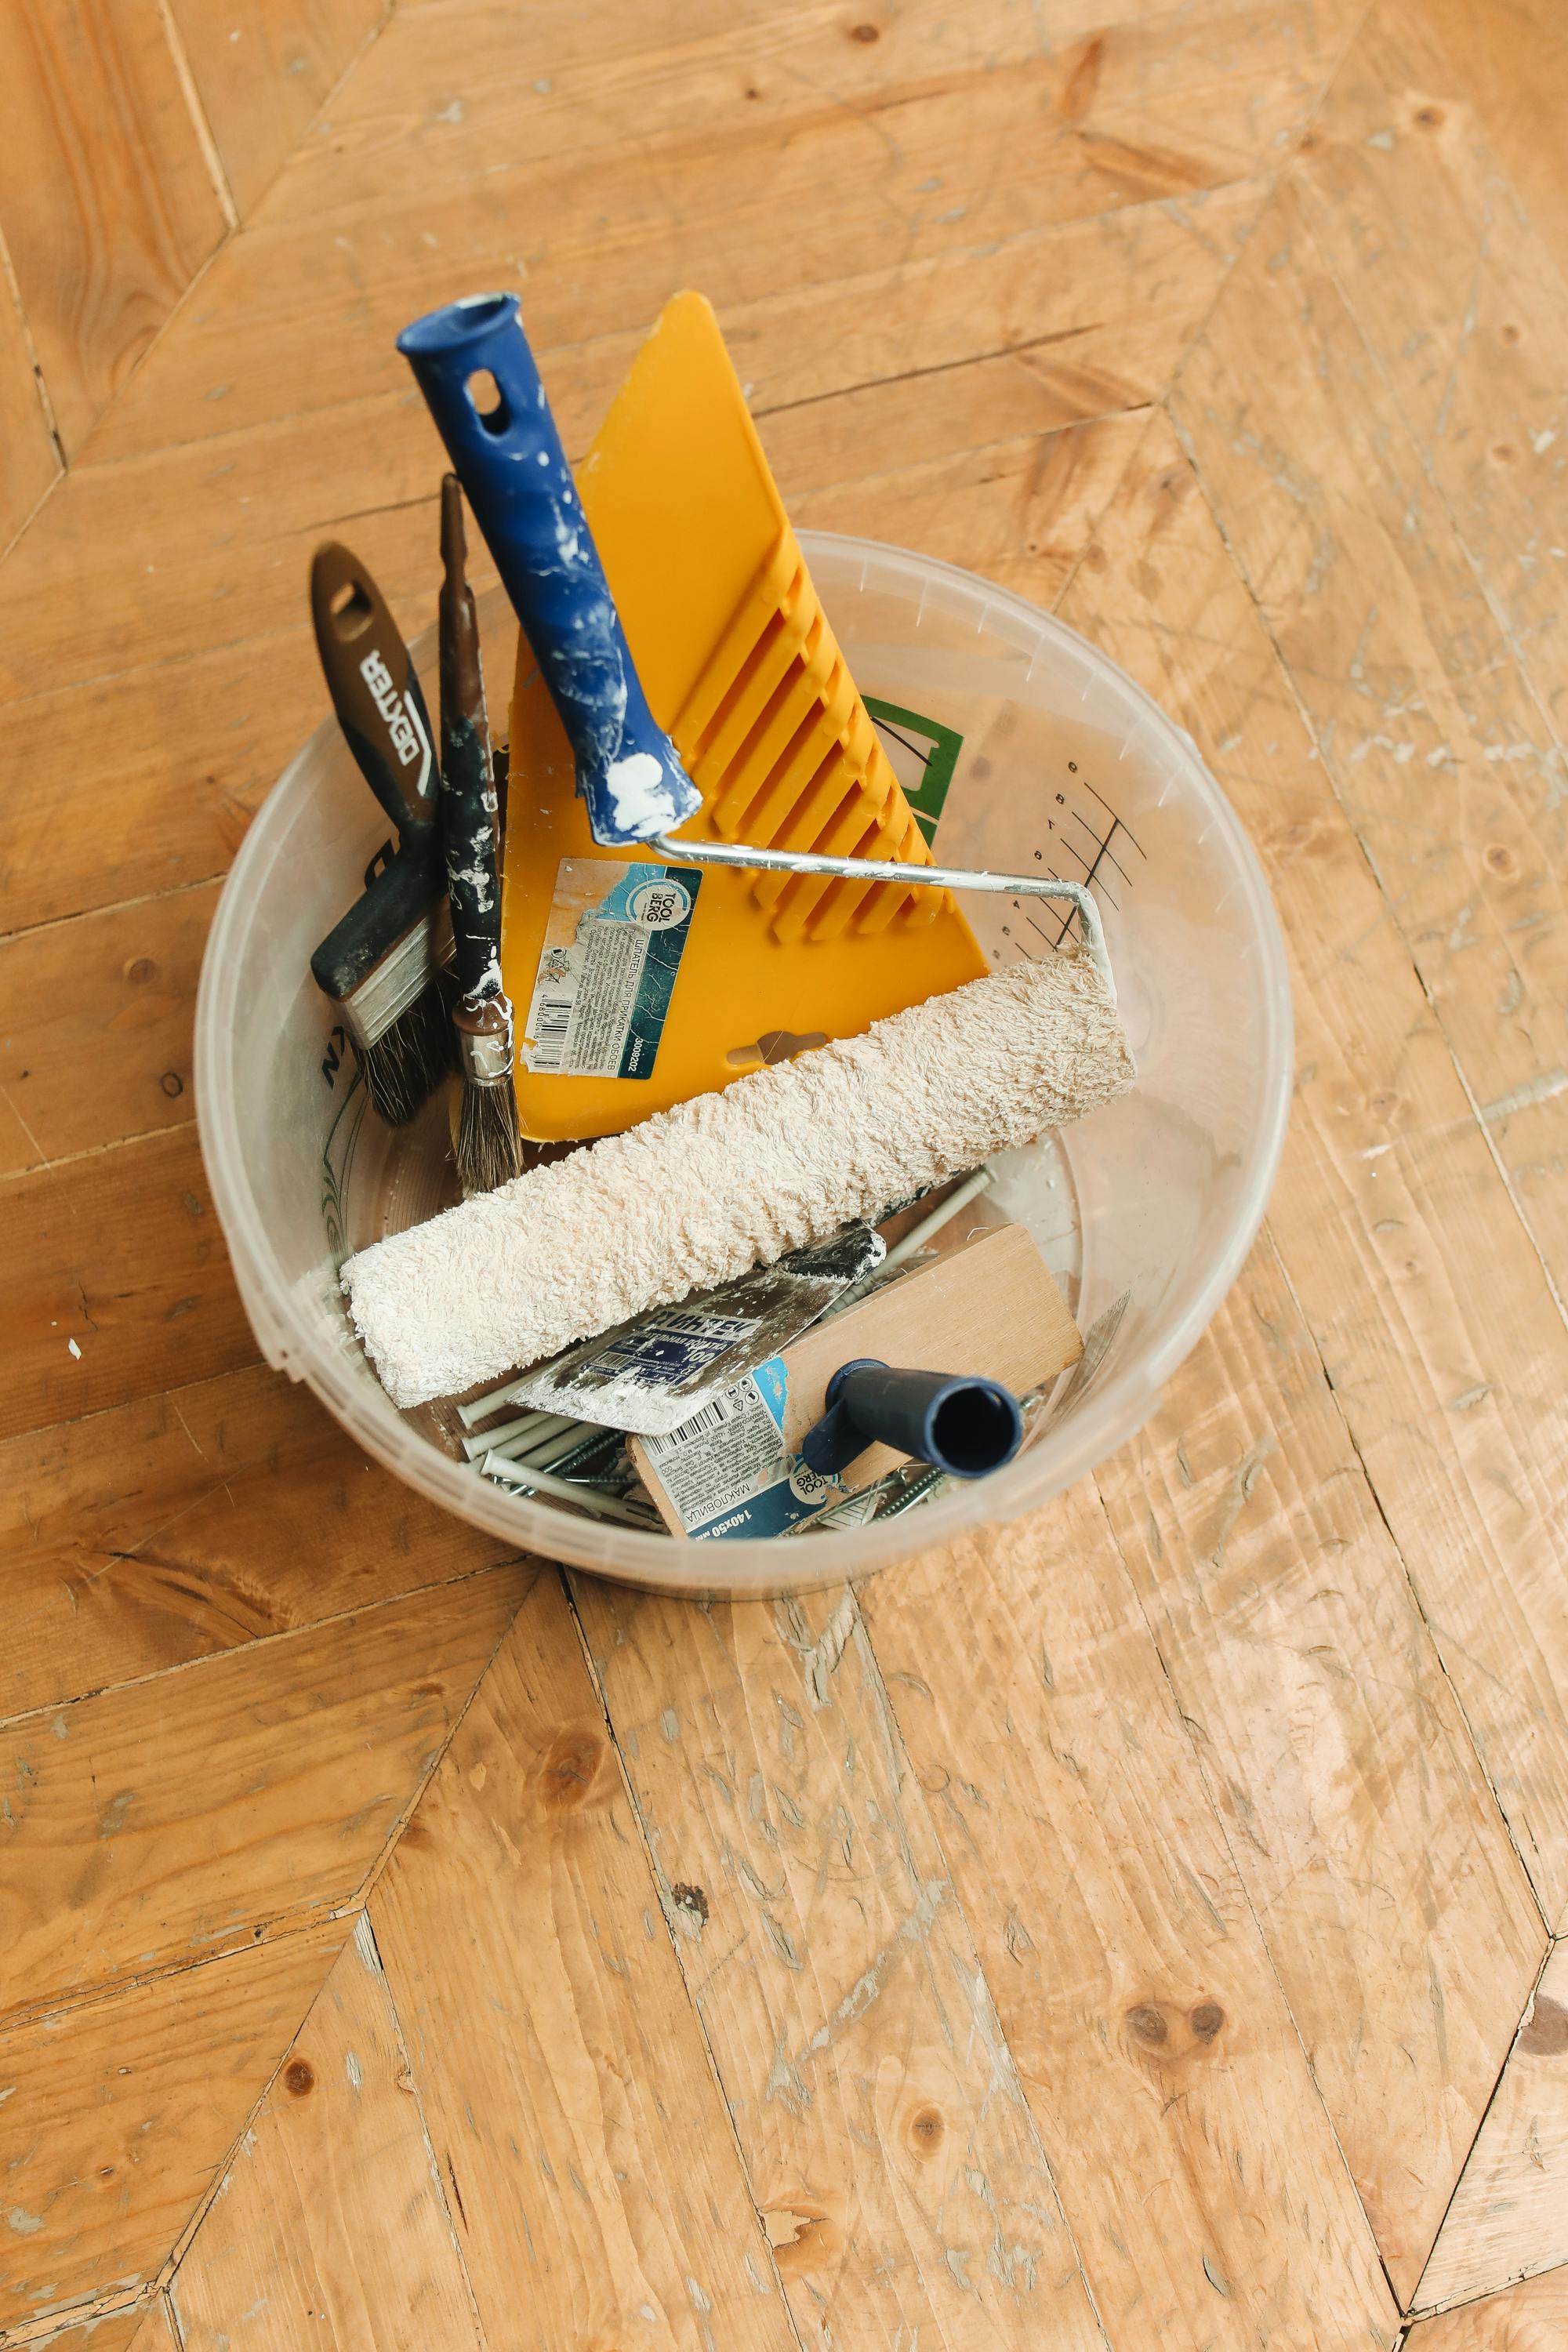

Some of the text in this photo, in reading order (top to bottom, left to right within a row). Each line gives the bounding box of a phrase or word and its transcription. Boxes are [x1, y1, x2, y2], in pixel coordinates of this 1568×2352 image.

[360, 649, 420, 766] DEXTER
[645, 892, 663, 922] BERG
[658, 892, 677, 923] TOOL
[606, 939, 644, 1069] ШПАТЕЛЬ ДЛЯ ПРИКАТКИ ОБОЕВ
[627, 1037, 643, 1071] 3009202
[681, 1349, 715, 1364] 100
[684, 1338, 729, 1350] ЛОПАТКА
[795, 1470, 817, 1488] ERG
[800, 1475, 828, 1496] TOOL
[685, 1483, 750, 1523] МАКЛОВИЦА
[710, 1508, 752, 1537] 140x50
